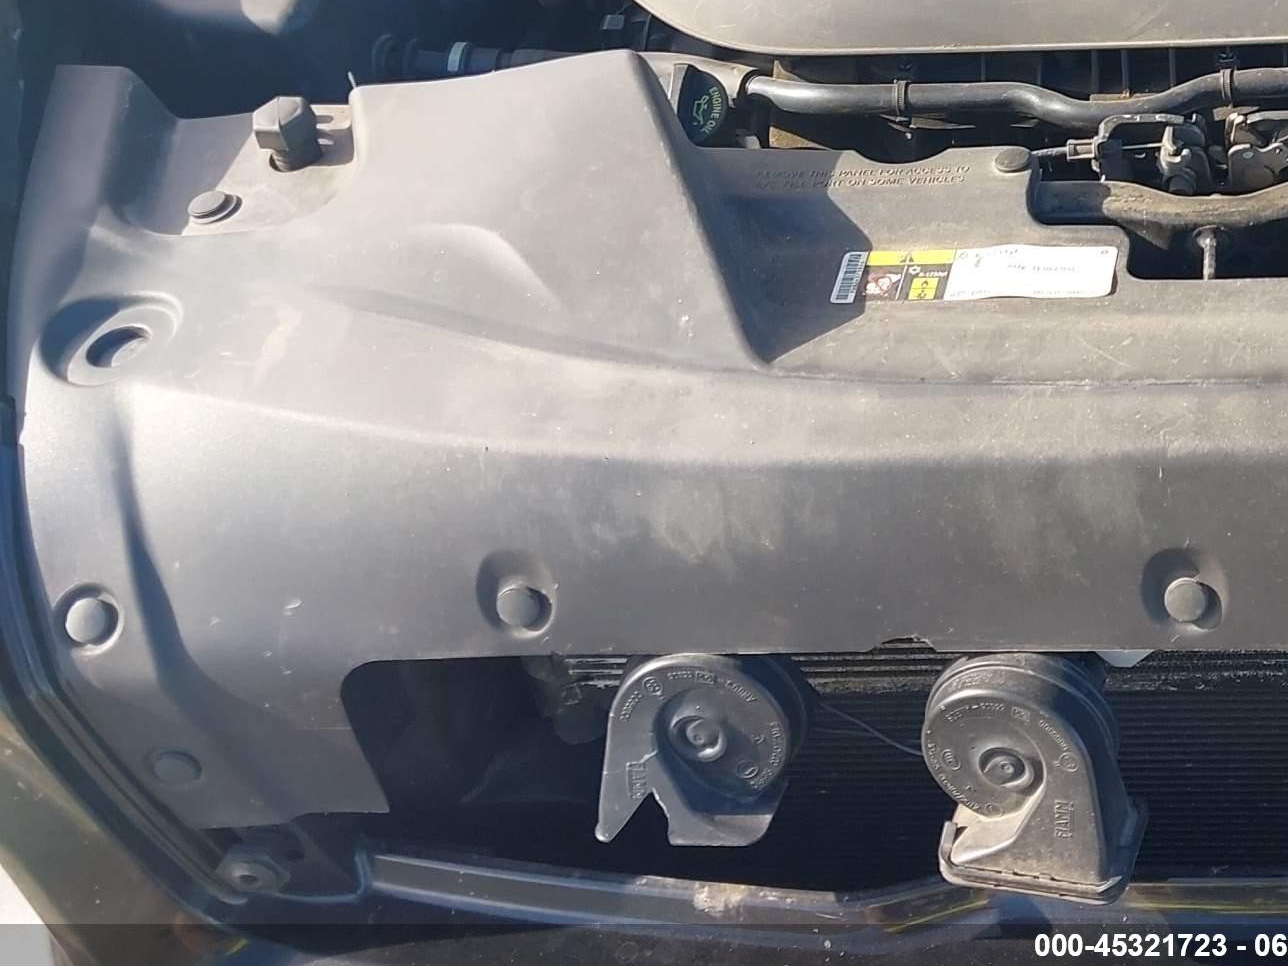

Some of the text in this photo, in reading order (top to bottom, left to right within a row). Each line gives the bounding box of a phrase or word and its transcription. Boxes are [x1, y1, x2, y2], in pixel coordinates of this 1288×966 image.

[700, 86, 722, 134] ENGINE OIL
[838, 169, 875, 177] PANEL
[879, 167, 904, 176] FOR
[905, 166, 951, 175] ACCESS
[955, 165, 970, 173] TO
[847, 178, 866, 186] ON
[869, 177, 905, 186] SOME
[908, 175, 966, 184] VEHICLES
